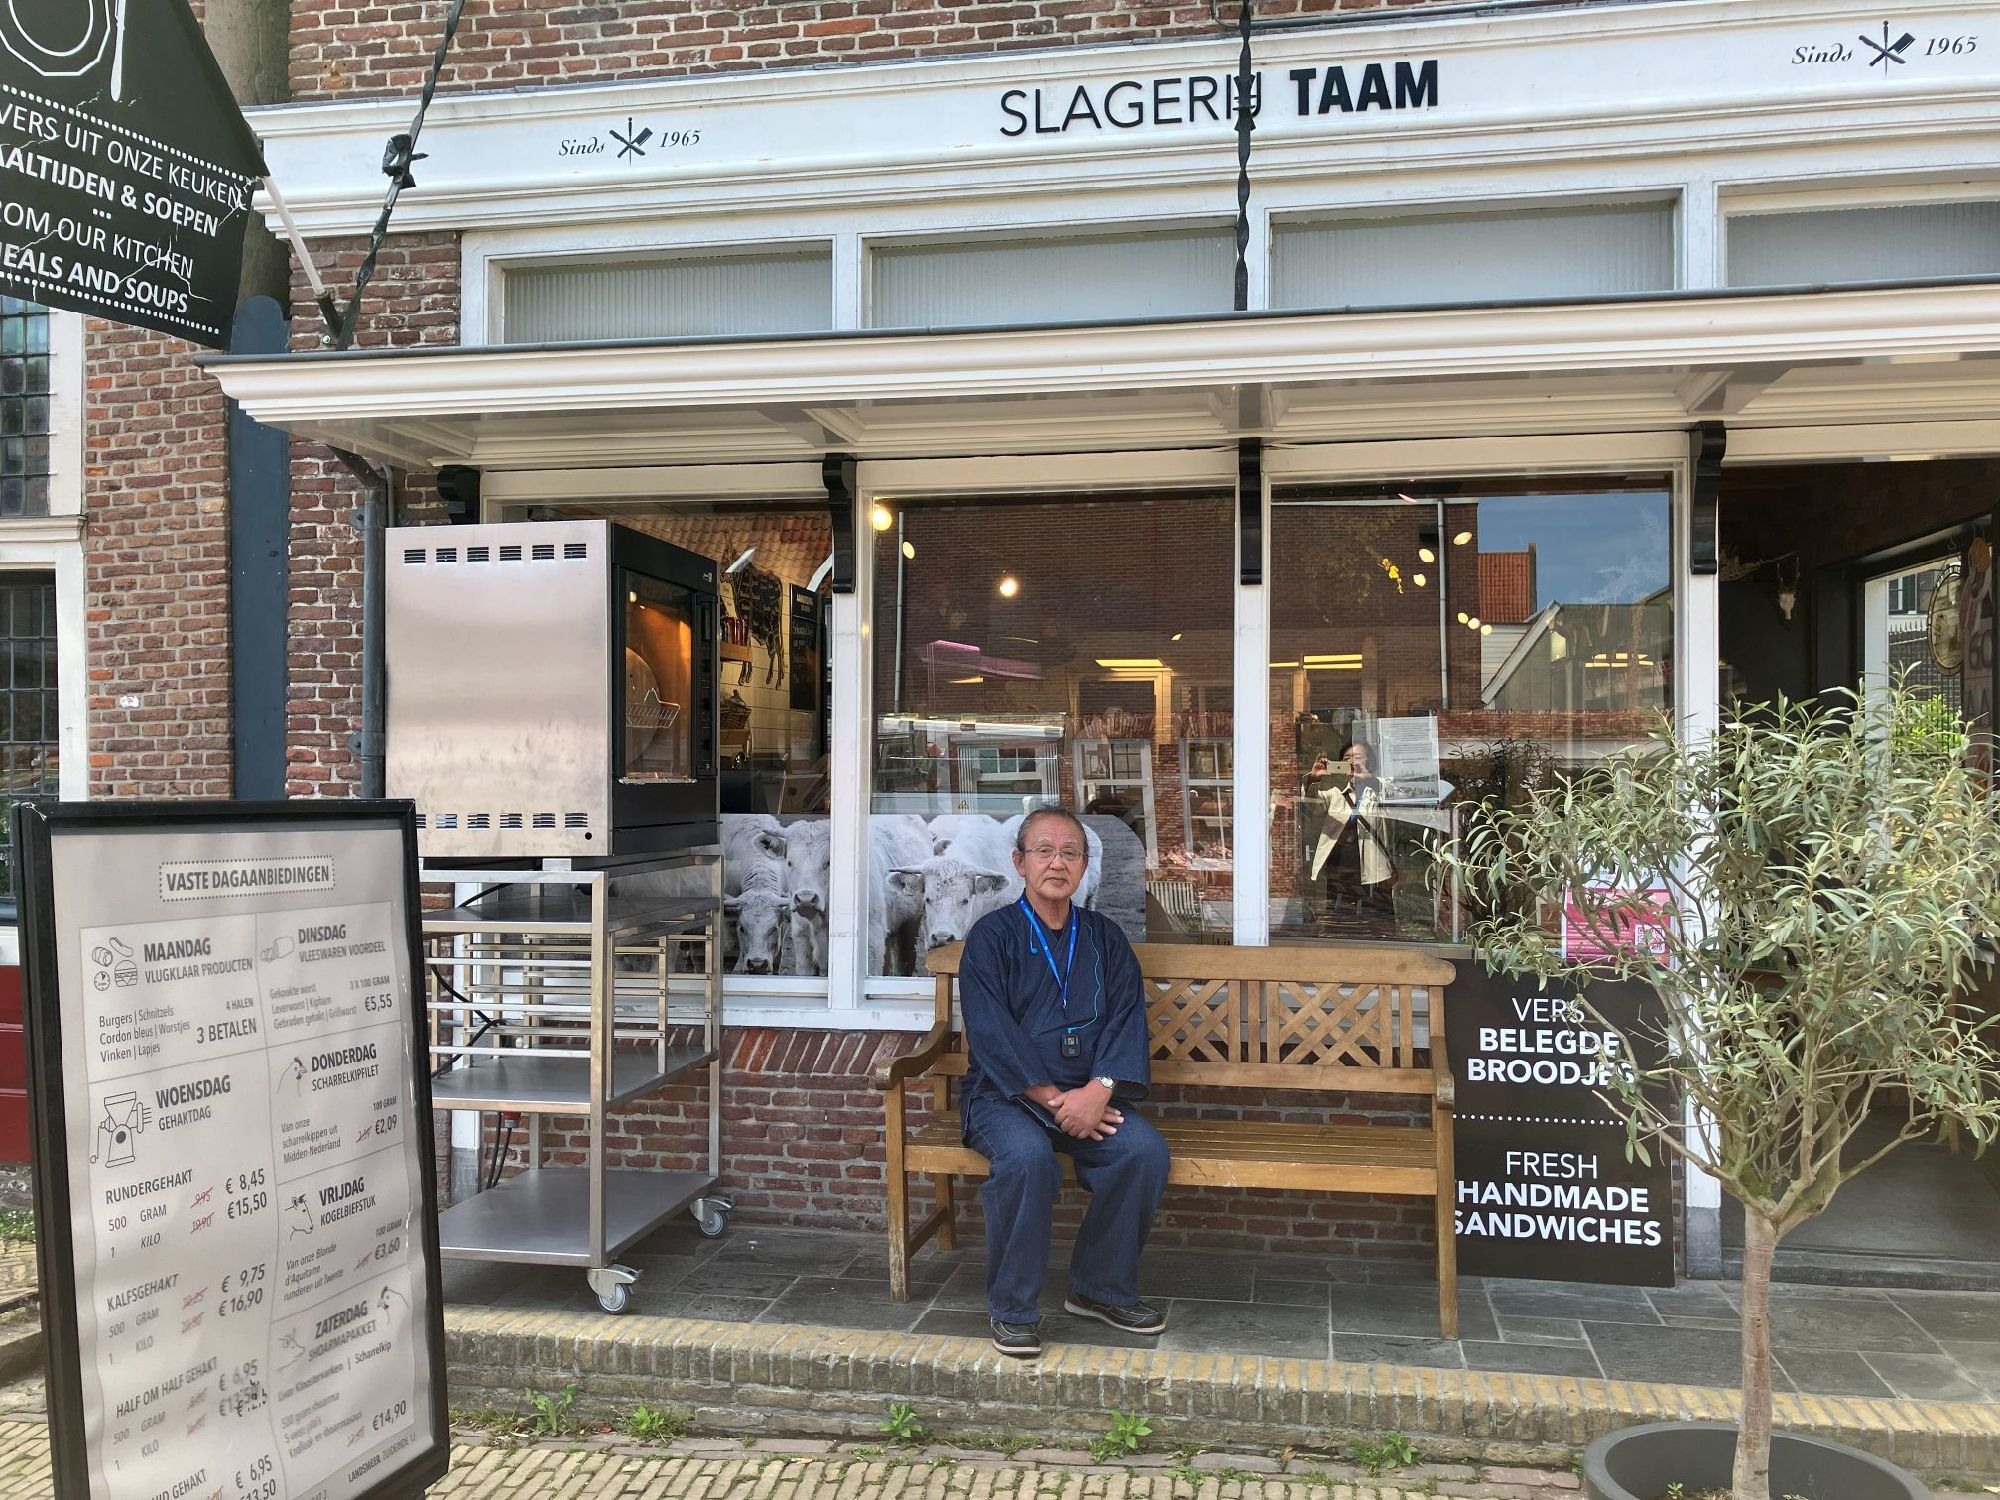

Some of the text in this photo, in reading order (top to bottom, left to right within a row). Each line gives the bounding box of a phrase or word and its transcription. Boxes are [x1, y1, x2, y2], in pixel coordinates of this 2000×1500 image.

[1791, 33, 1980, 65] Sinds 1965
[1289, 60, 1438, 116] TAAM
[558, 130, 701, 156] Sinds 1965
[65, 122, 103, 156] UIT
[107, 140, 163, 180] ONZE
[168, 162, 247, 210] KEUKEN
[120, 184, 137, 209] &
[142, 192, 218, 237] SOEPEN
[0, 201, 194, 279] OM OUR KITCHEN
[68, 261, 120, 294] AND
[124, 277, 188, 313] SOUPS
[166, 865, 330, 891] VASTE DAGAANBIEDINGEN
[298, 924, 347, 944] DINSDAG
[143, 937, 212, 962] MAANDAG
[299, 941, 387, 962] VLEESWAREN VOORDEEL
[144, 958, 254, 984] VLUGKLAAR PRODUCTEN
[372, 975, 391, 985] GRAM
[225, 998, 254, 1011] 4 HALEN
[364, 993, 392, 1012] €5,55
[1512, 997, 1585, 1024] VERS
[99, 1005, 174, 1029] Burgers Schnitzels
[196, 1018, 257, 1044] 3 BETALEN
[99, 1020, 190, 1045] Cordon bleus Worstjes
[1479, 1027, 1620, 1058] BELEGDE
[100, 1042, 161, 1063] Vinken Lapjes
[311, 1043, 377, 1073] DONDERDAG
[311, 1064, 379, 1092] SCHARRELKIPFILET
[1467, 1058, 1635, 1086] BROODJES
[156, 1075, 231, 1109] WOENSDAG
[373, 1096, 398, 1112] 100 GRAM
[158, 1105, 211, 1131] GEHAKTDAG
[375, 1114, 398, 1135] €2,09
[283, 1139, 341, 1163] Midden-Nederland
[1506, 1151, 1597, 1179] FRESH
[105, 1169, 194, 1205] RUNDERGEHAKT
[225, 1168, 265, 1194] € 8,45
[319, 1176, 365, 1206] VRIJDAG
[227, 1191, 267, 1219] €15,50
[320, 1194, 376, 1226] KOGELBIEFSTUK
[1458, 1180, 1649, 1212] HANDMADE
[108, 1204, 167, 1231] 500 GRAM
[386, 1218, 402, 1233] GRAM
[1453, 1210, 1662, 1246] SANDWICHES
[140, 1232, 161, 1249] KILO
[374, 1237, 400, 1260] €3,60
[286, 1243, 336, 1271] Van onze Blonde
[107, 1273, 179, 1311] KALFSGEHAKT
[221, 1263, 265, 1293] € 9,75
[230, 1288, 263, 1312] 16,90
[109, 1308, 160, 1337] 500 GRAM
[315, 1301, 368, 1339] ZATERDAG
[136, 1335, 153, 1352] KILO
[308, 1320, 376, 1362] SHOARMAPAKKET
[354, 1340, 392, 1364] Scharrelkip
[116, 1396, 140, 1419] HALF
[143, 1387, 159, 1405] OM
[161, 1374, 184, 1397] HALF
[186, 1357, 218, 1384] GEHAKT
[113, 1429, 129, 1445] 500
[141, 1411, 165, 1432] GRAM
[372, 1400, 407, 1431] €14,90
[141, 1439, 159, 1458] KILO
[235, 1454, 272, 1489] € 6,95
[348, 1454, 382, 1483] LANDSMEER
[172, 1468, 206, 1499] GEHAKT
